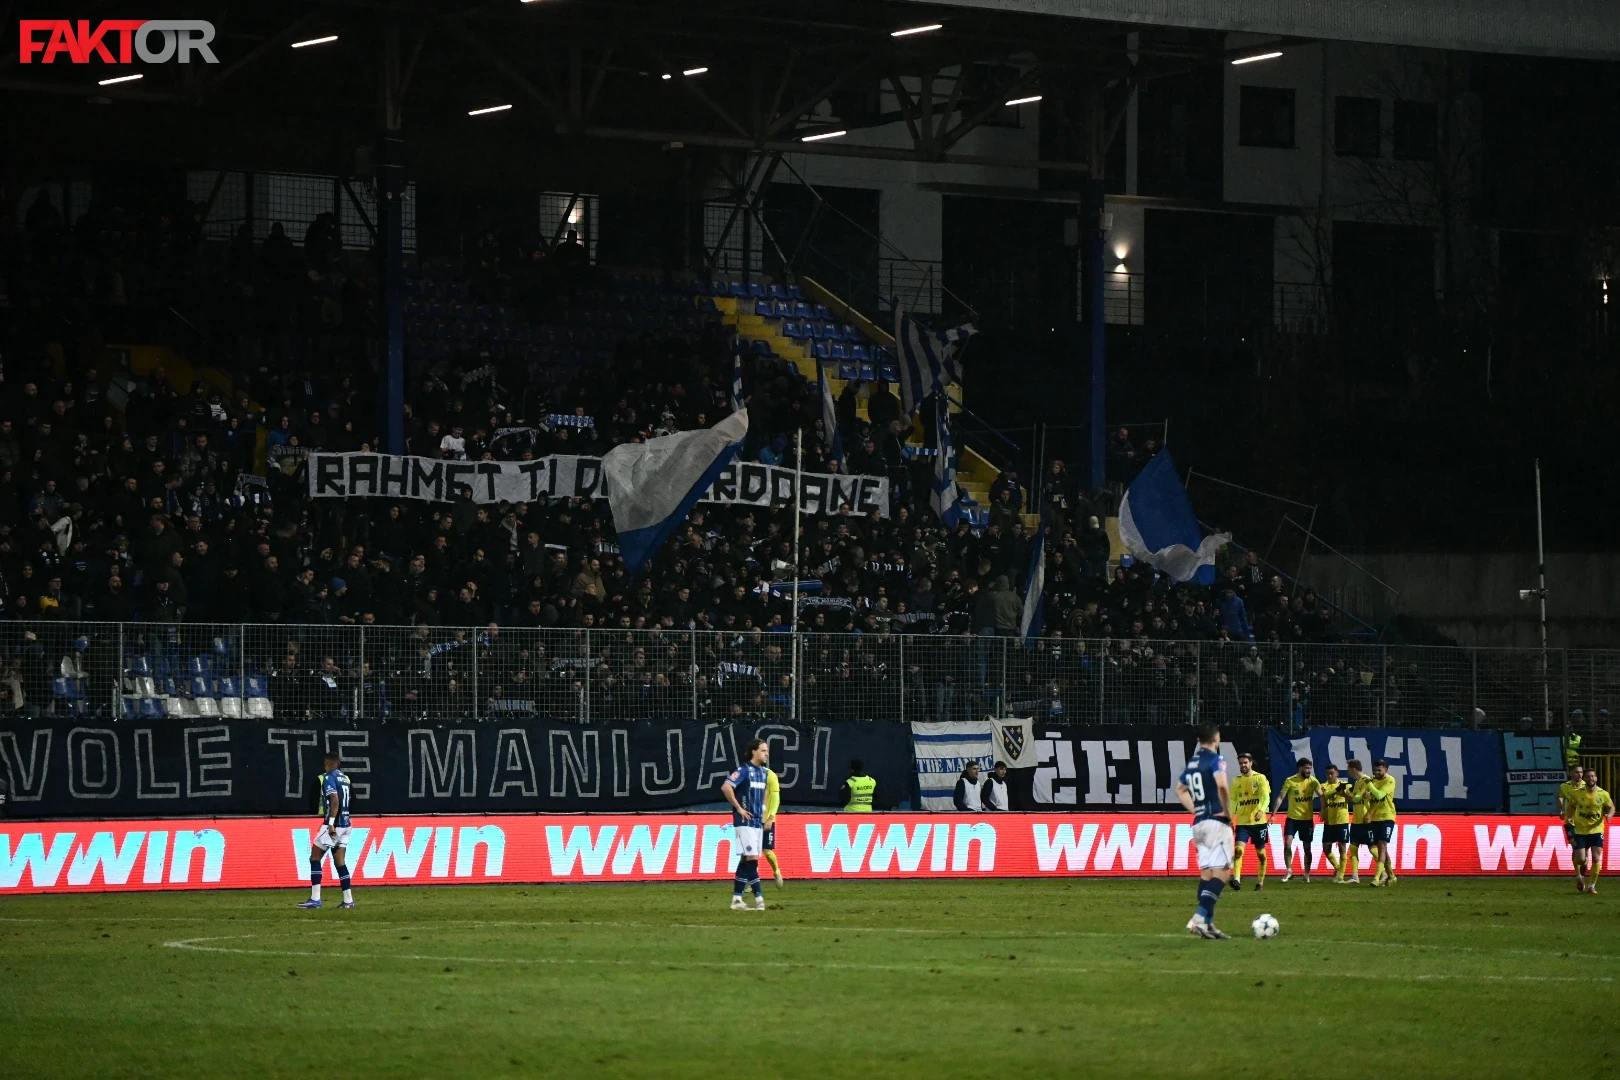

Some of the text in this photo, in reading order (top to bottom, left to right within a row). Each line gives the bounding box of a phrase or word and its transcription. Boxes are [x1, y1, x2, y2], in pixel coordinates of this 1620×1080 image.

[317, 455, 502, 501] RAHMET
[518, 458, 558, 500] TI
[0, 722, 832, 802] VOLE TE MANIJACI
[916, 758, 944, 773] THE
